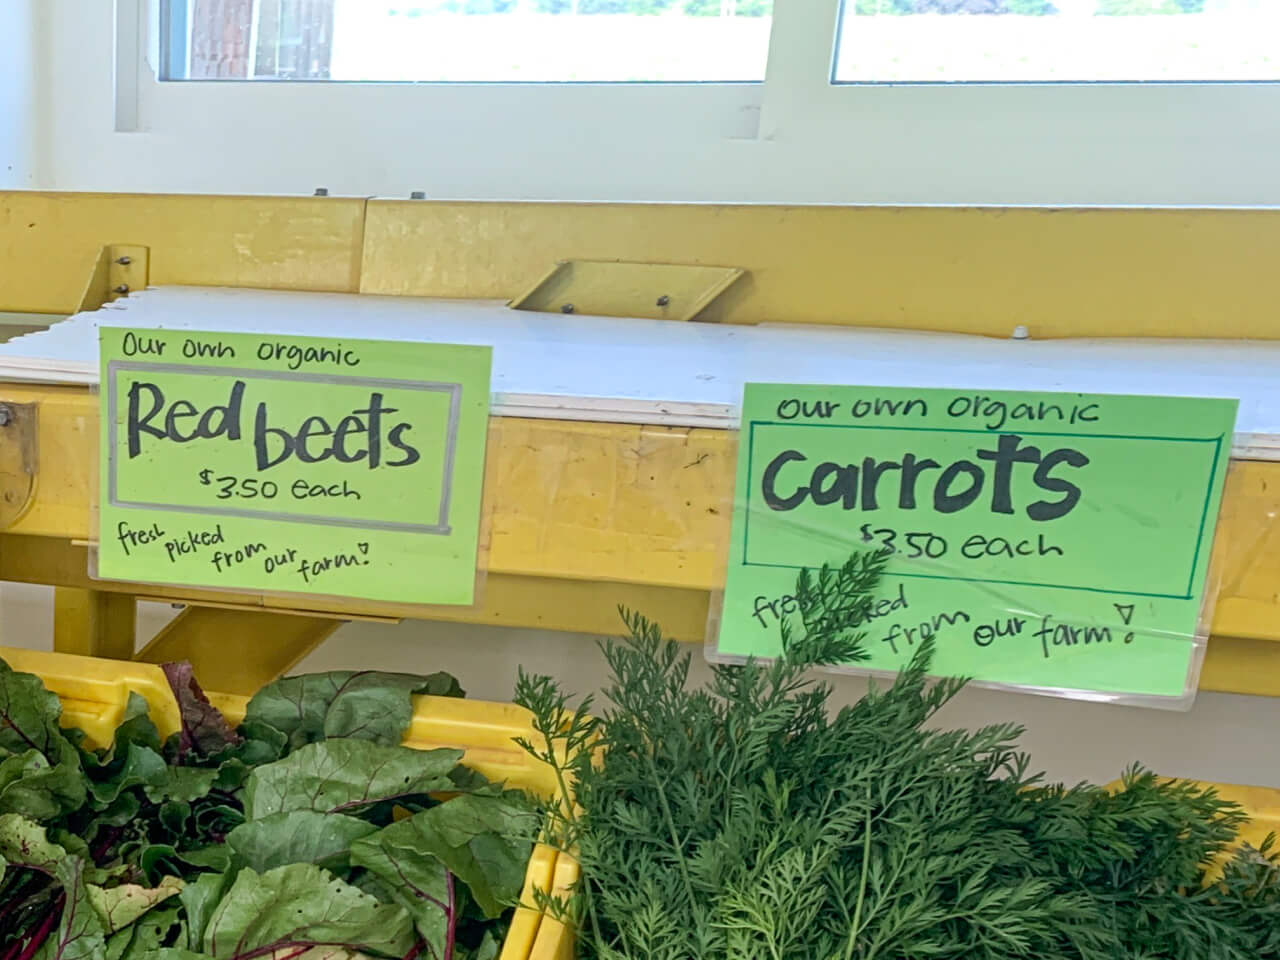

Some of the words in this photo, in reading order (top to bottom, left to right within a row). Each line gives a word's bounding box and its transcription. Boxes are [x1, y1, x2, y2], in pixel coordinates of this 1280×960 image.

[122, 331, 167, 357] Our
[182, 338, 235, 358] own
[257, 341, 360, 370] organic
[128, 380, 247, 459] Red
[254, 392, 420, 472] beets
[852, 398, 928, 419] own
[199, 468, 278, 499] $3.50
[291, 479, 361, 500] each
[117, 521, 165, 555] fresh
[165, 524, 224, 562] picked
[211, 542, 267, 572] from
[264, 547, 297, 574] our
[859, 523, 949, 559] $3.50
[961, 534, 1064, 559] each
[881, 611, 970, 654] from
[974, 617, 1027, 646] our
